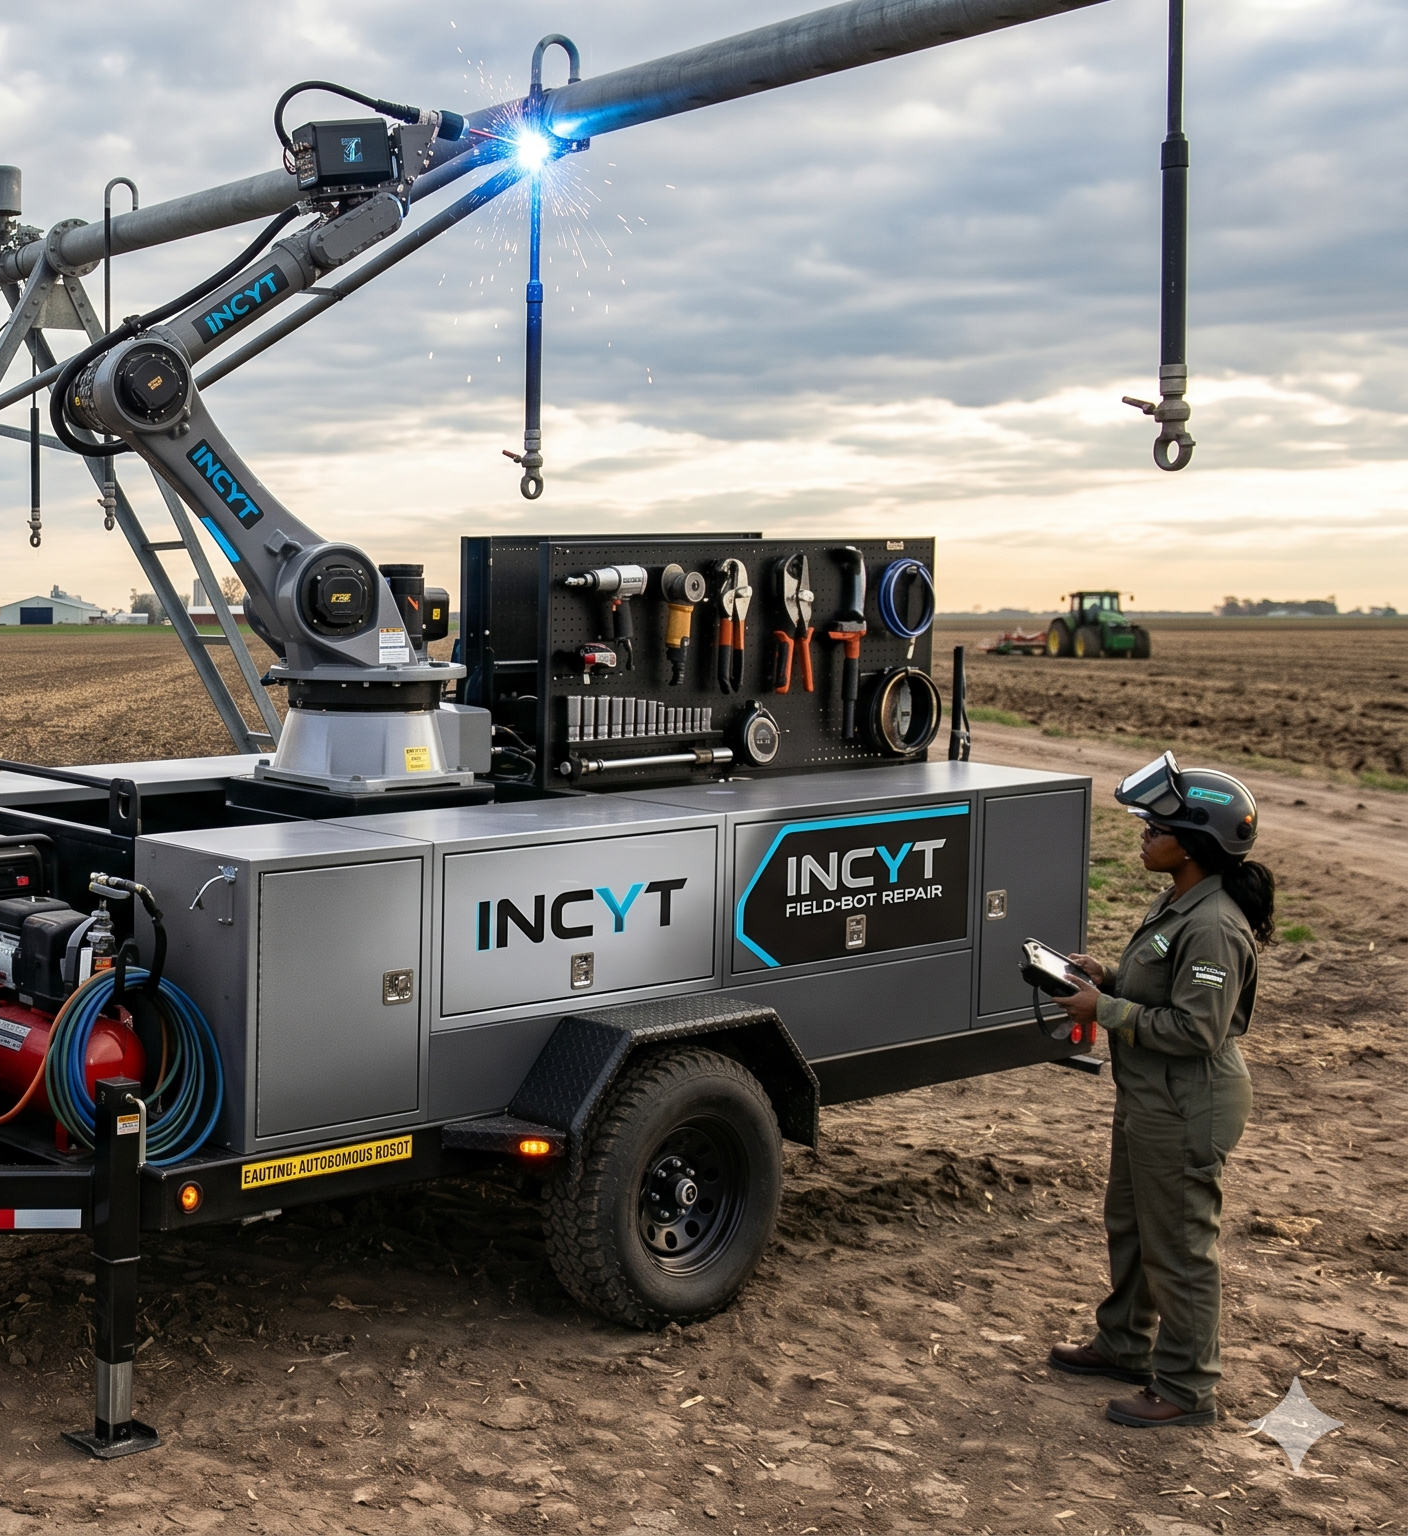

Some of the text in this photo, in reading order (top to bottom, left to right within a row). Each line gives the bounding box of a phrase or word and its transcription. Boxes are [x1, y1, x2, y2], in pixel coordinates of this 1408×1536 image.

[204, 271, 278, 335] INCYT
[192, 445, 260, 519] INCYT
[786, 838, 947, 897] INCYT
[475, 877, 689, 952] INCYT
[785, 884, 943, 918] FIELD-BOT REPAIR
